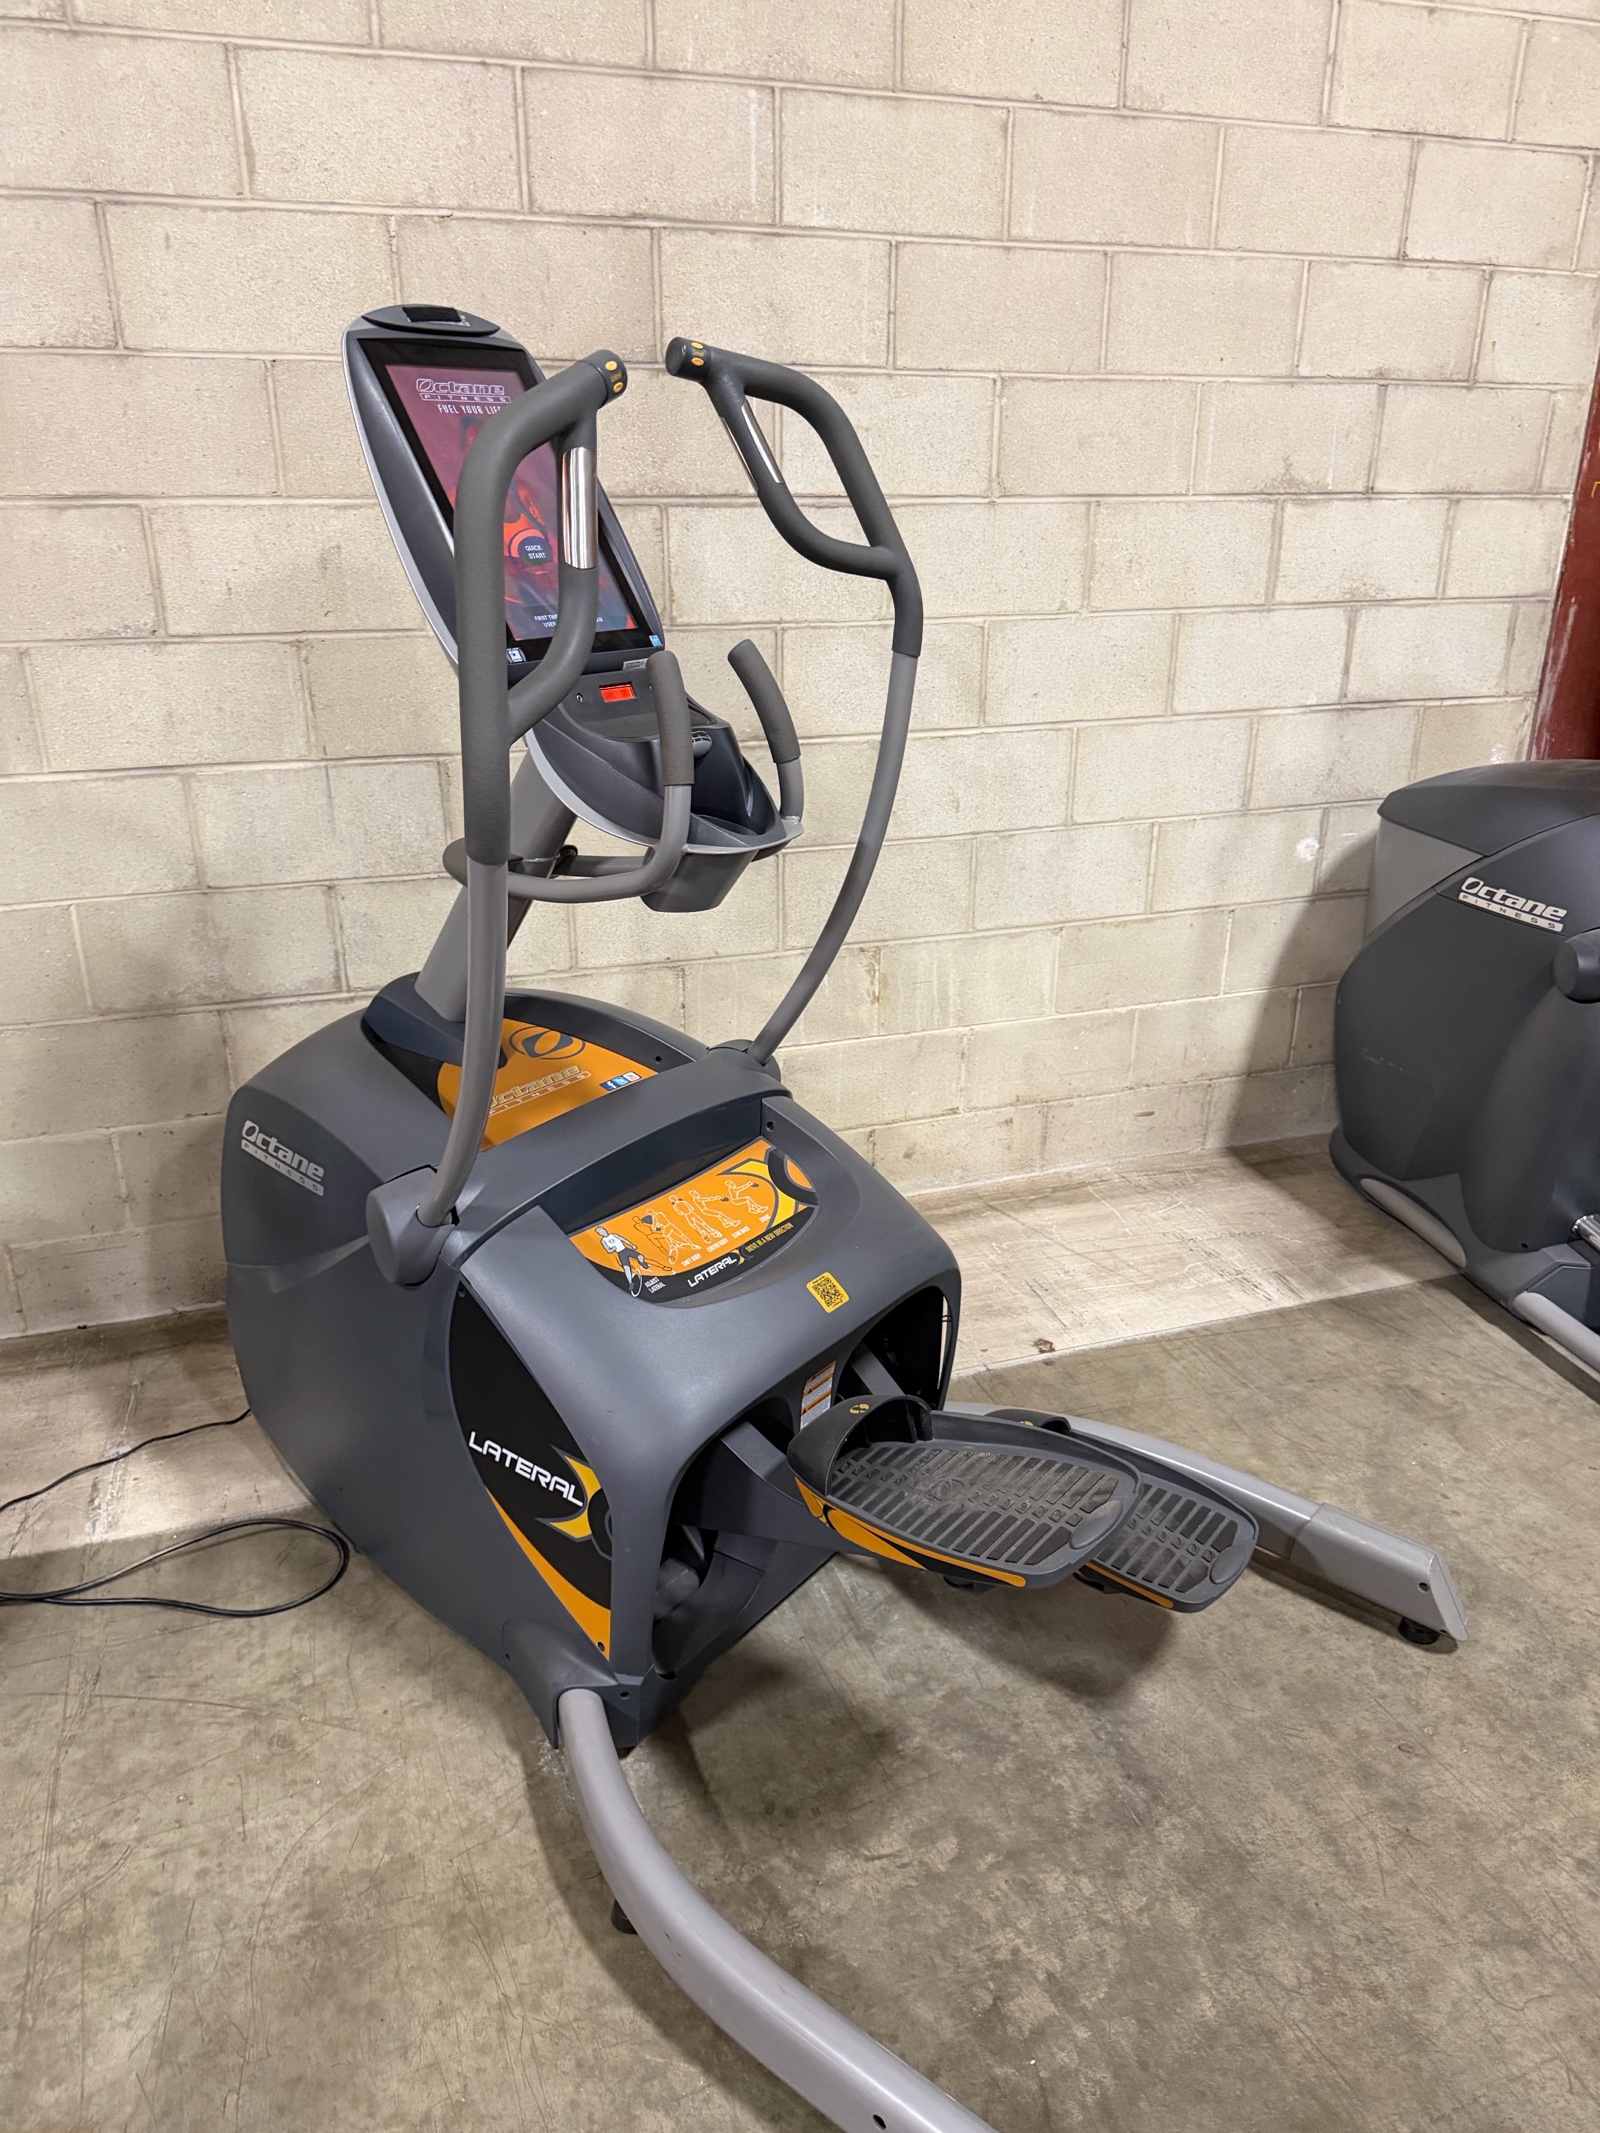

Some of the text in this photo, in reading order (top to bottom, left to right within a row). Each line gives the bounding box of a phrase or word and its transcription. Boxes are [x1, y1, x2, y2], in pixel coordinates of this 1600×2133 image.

[416, 378, 505, 396] Octane
[422, 394, 508, 403] FITNESS
[437, 404, 459, 414] FUEL
[460, 405, 483, 414] YOUR
[524, 544, 543, 552] QUICK
[528, 552, 547, 560] START
[533, 614, 548, 622] FIRST
[1460, 877, 1568, 921] Octane
[1459, 892, 1560, 931] FITNESS
[489, 1071, 588, 1116] FITNESS
[242, 1119, 325, 1182] Octane
[242, 1140, 322, 1194] FITNESS
[745, 1241, 760, 1253] MOVE
[763, 1232, 776, 1242] NEW
[772, 1222, 794, 1237] DIRECTION
[644, 1276, 660, 1288] ADJUST
[687, 1255, 737, 1288] LATERAL
[648, 1281, 667, 1294] LATERAL
[468, 1430, 584, 1508] LATERAL
